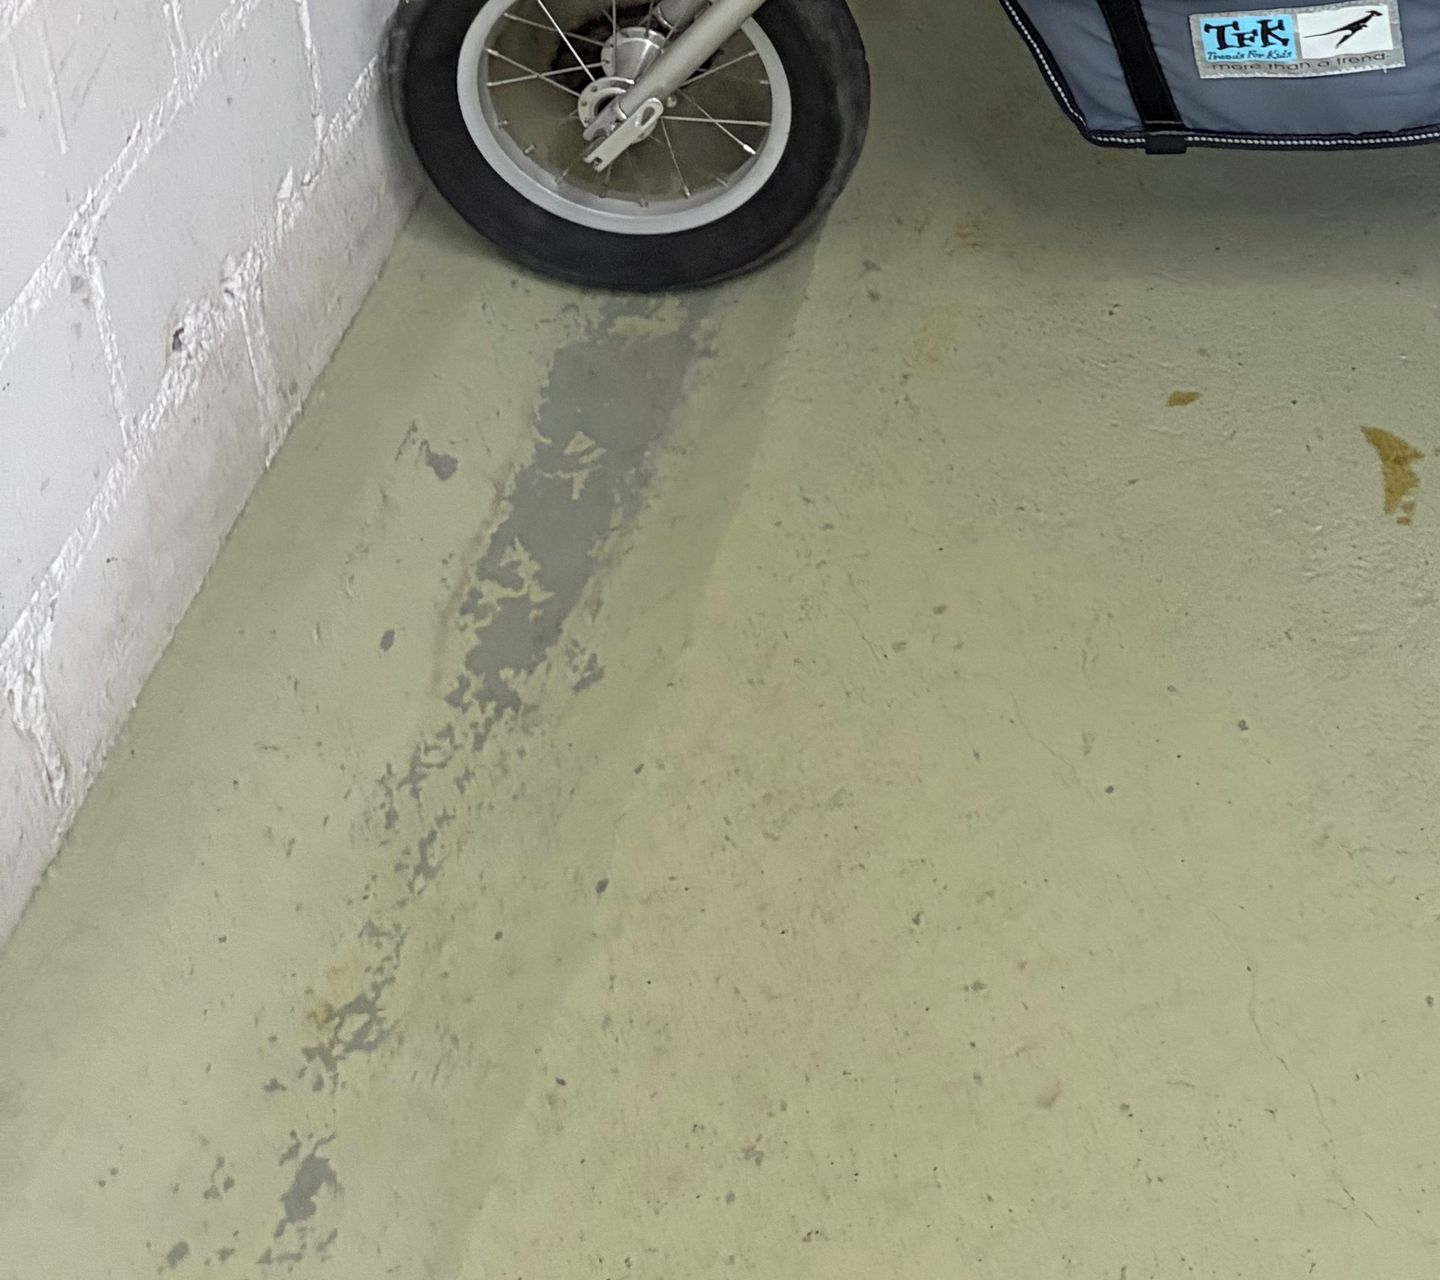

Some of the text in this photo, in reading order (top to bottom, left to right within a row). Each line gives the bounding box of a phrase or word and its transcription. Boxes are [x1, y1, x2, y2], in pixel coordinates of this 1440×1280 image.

[1203, 19, 1290, 50] TFK
[1207, 49, 1292, 61] Trends For Kids
[1268, 61, 1311, 71] than
[1317, 60, 1330, 68] a
